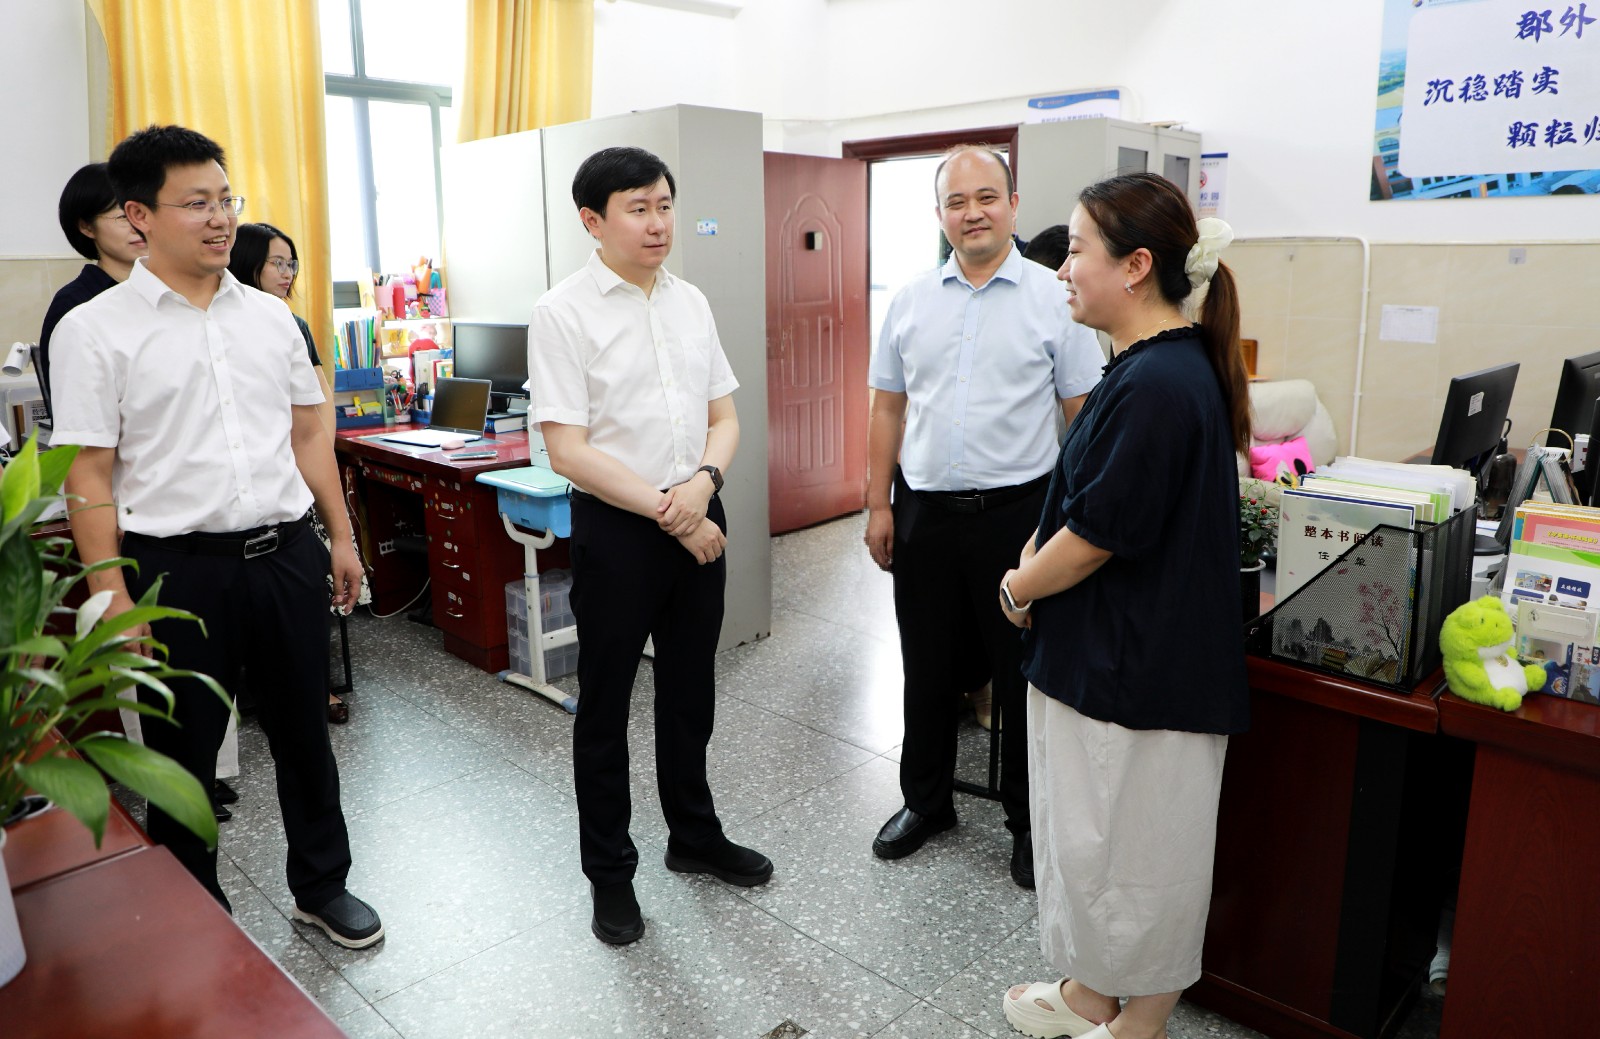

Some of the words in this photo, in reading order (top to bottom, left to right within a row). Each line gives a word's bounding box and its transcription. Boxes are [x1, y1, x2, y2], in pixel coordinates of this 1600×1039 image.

[1514, 3, 1598, 43] 郡外
[1423, 66, 1560, 106] 沉稳踏实
[1318, 551, 1366, 566] 任单
